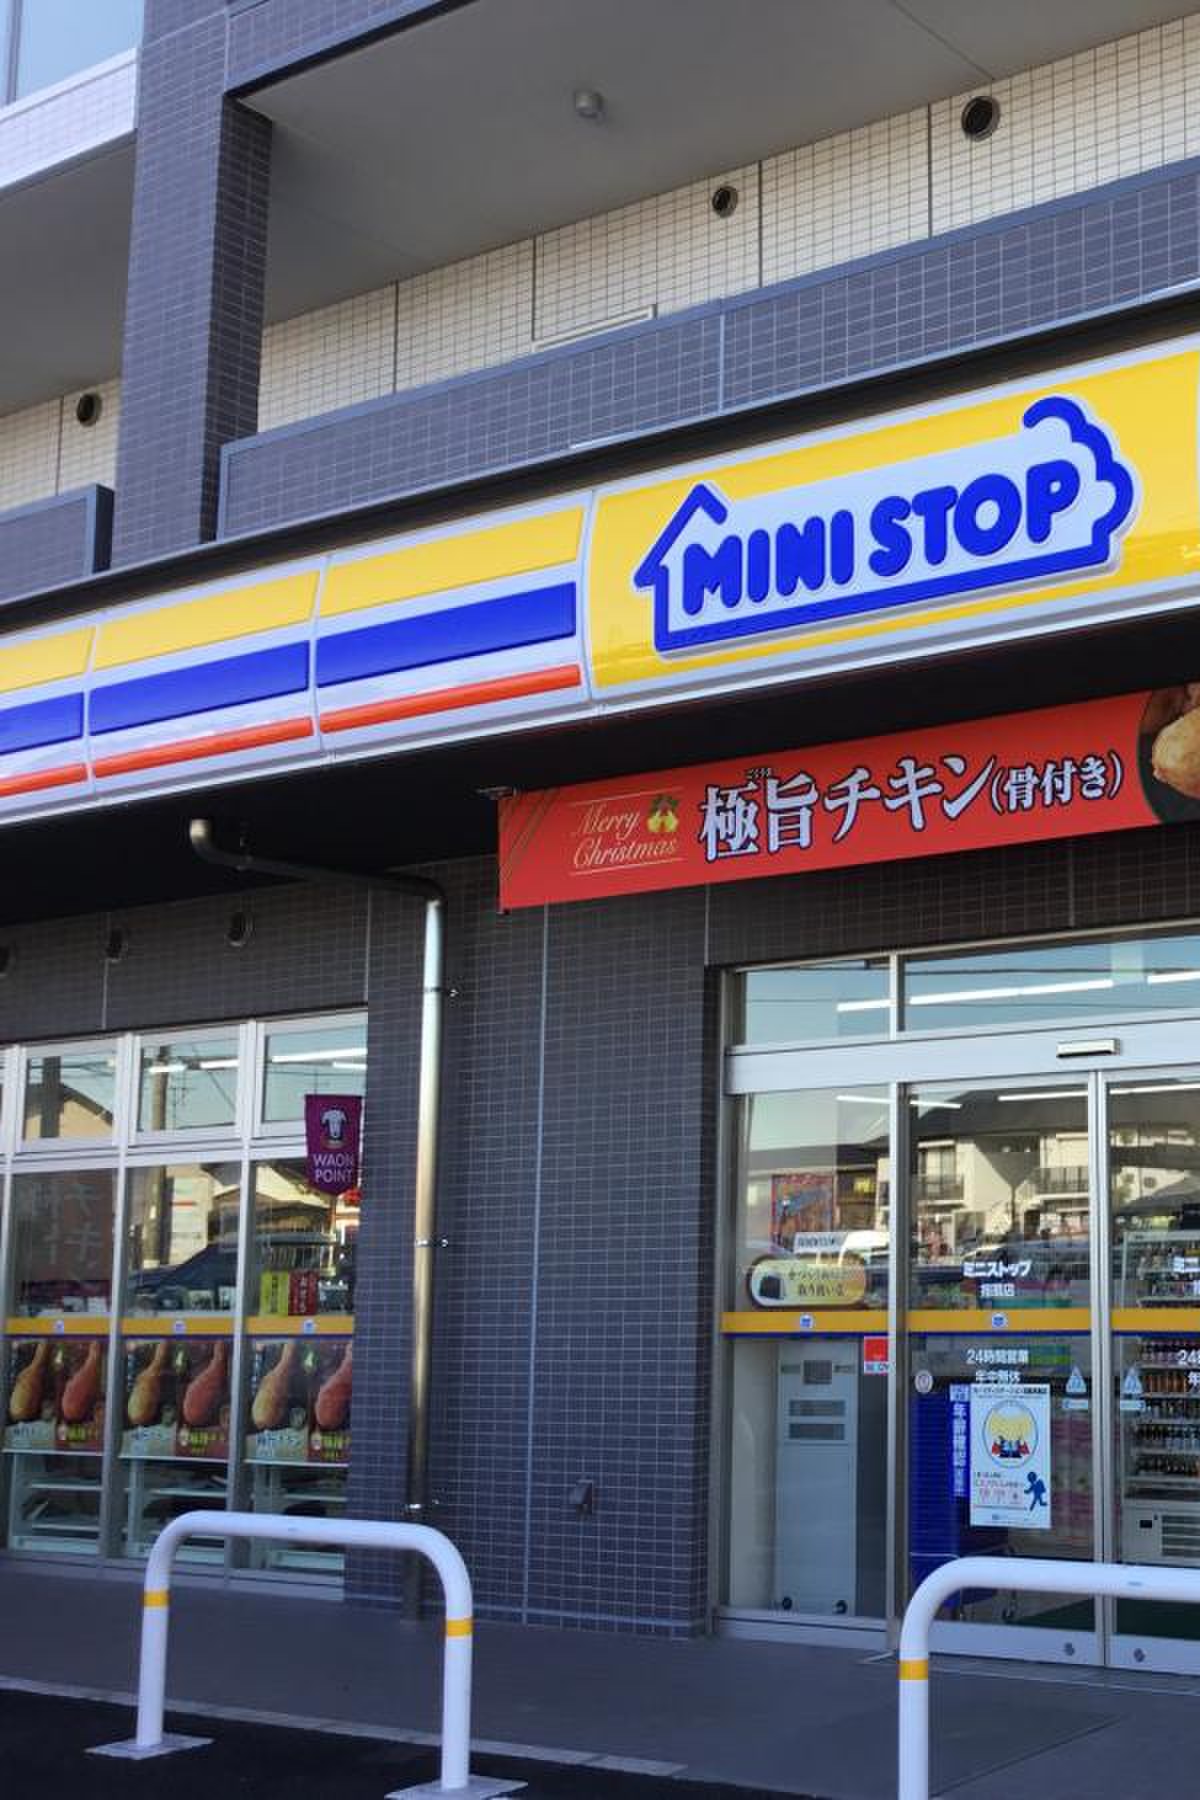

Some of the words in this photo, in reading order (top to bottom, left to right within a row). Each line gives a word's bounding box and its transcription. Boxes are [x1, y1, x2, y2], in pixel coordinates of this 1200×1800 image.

[577, 803, 641, 841] Merry
[573, 836, 678, 869] Christmas
[313, 1153, 354, 1167] WAON
[314, 1168, 354, 1183] POINT
[963, 1259, 1032, 1278] ミニストップ
